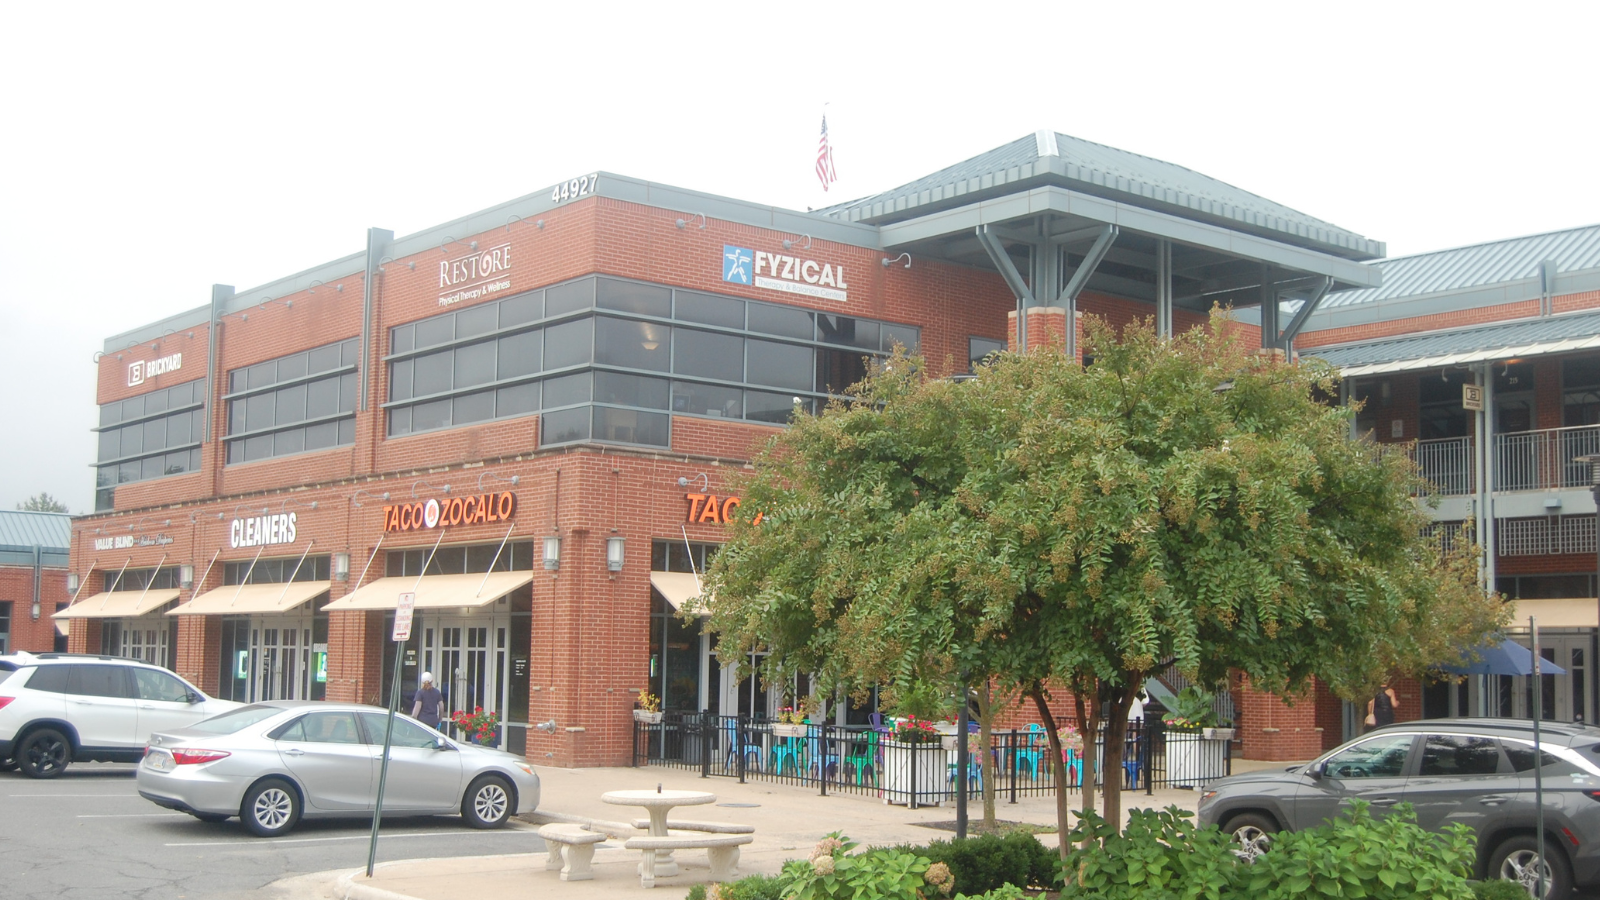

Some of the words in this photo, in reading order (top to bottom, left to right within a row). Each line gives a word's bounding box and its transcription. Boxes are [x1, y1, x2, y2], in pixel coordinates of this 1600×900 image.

[552, 173, 598, 203] 44927
[755, 250, 847, 289] FYZICAL
[438, 293, 460, 307] Physical
[460, 288, 482, 301] Therapy
[482, 286, 487, 295] &
[488, 280, 511, 293] Wellness
[758, 278, 784, 291] Therapy
[786, 282, 791, 290] &
[792, 283, 819, 296] Balance
[820, 288, 846, 300] Centers
[147, 352, 182, 378] BRICKYARD
[382, 502, 424, 532] TACO
[438, 491, 515, 526] ZOCALO
[686, 493, 764, 526] TAC
[95, 537, 114, 550] VALUE
[115, 535, 134, 549] BLIND
[231, 512, 298, 549] CLEANERS
